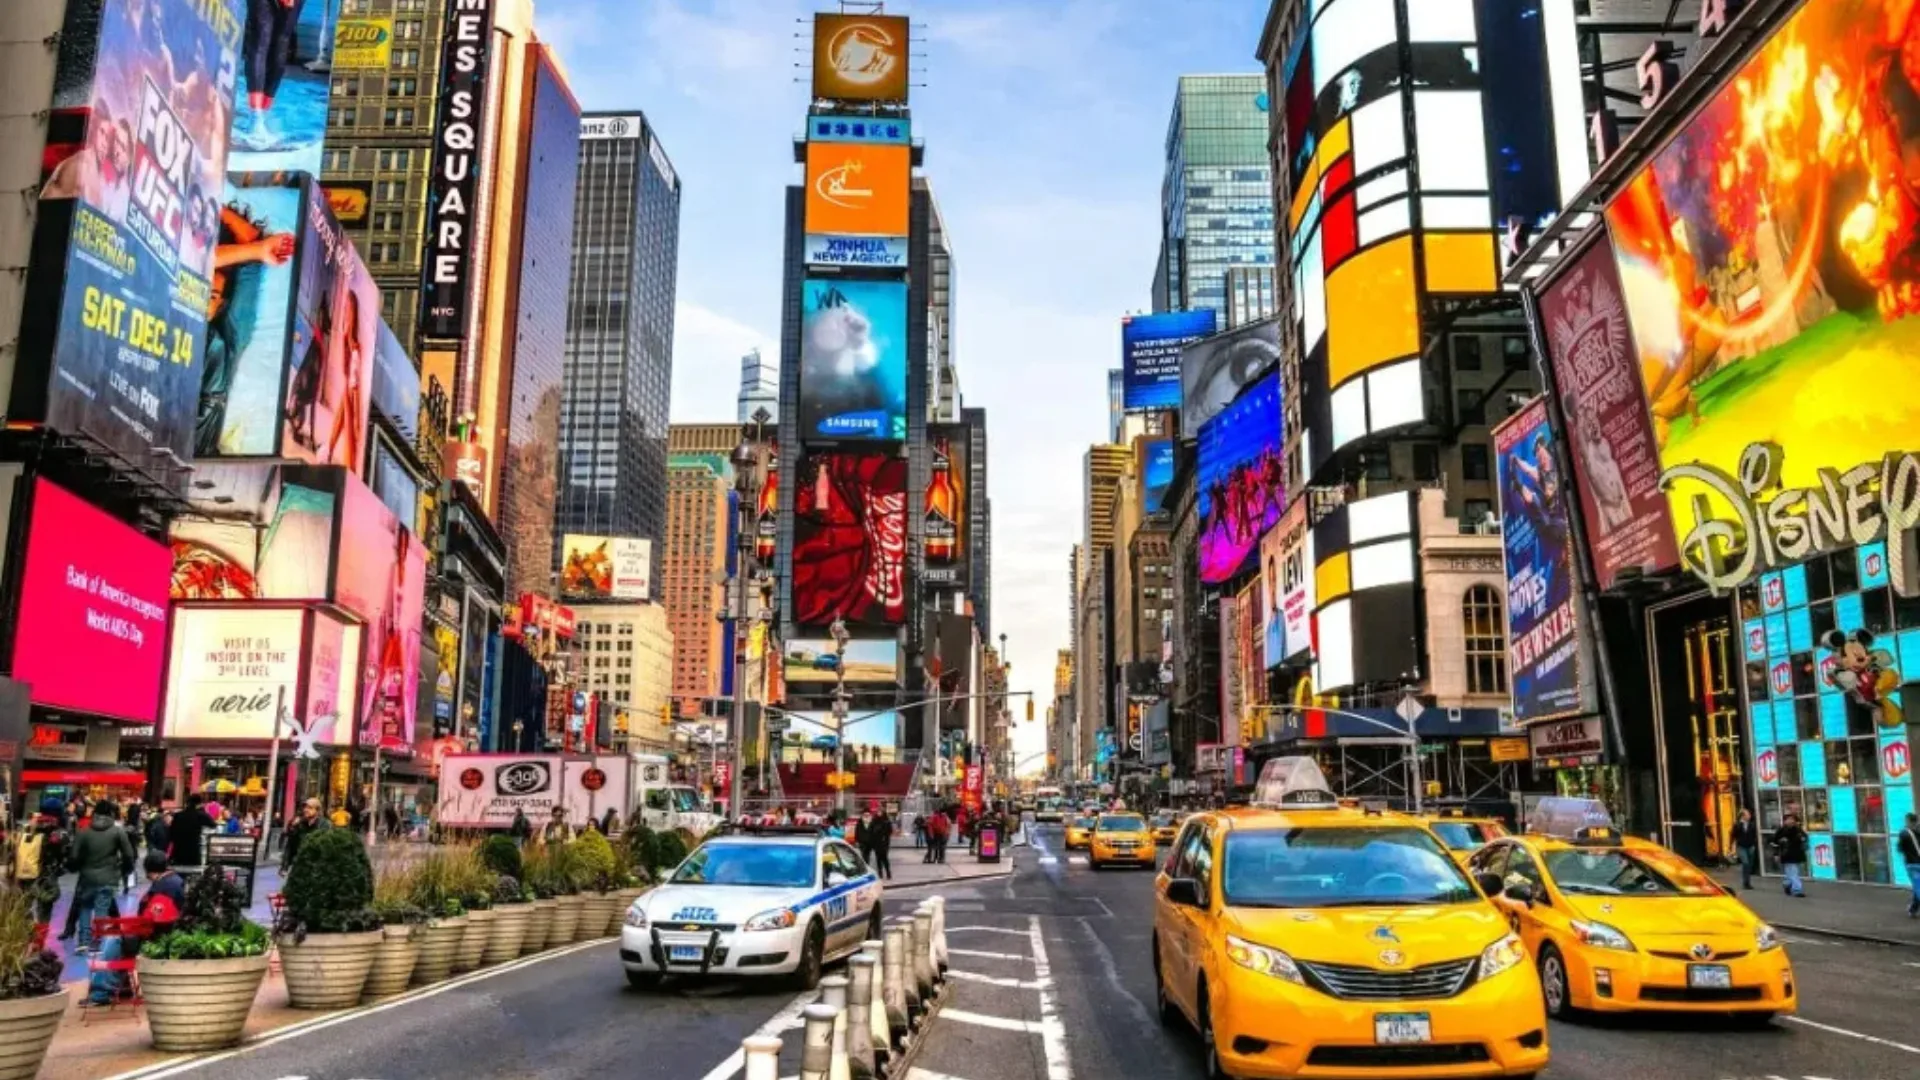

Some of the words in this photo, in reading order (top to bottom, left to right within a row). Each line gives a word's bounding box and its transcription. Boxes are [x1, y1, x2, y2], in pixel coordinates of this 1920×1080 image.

[140, 84, 191, 195] FOX
[134, 156, 182, 241] UFC
[435, 92, 475, 283] SQUARE
[127, 206, 178, 271] SATURDAY
[827, 239, 887, 252] XINHUA
[813, 251, 848, 262] NEWS
[850, 253, 900, 264] AGENCY
[431, 307, 455, 316] NYC
[82, 286, 127, 340] SAT.
[129, 307, 168, 359] DEC.
[170, 327, 193, 368] 14
[139, 386, 160, 422] FOX
[826, 418, 879, 429] SAMSUNG
[67, 563, 88, 590] Bank
[100, 579, 131, 608] America
[86, 607, 111, 633] World
[110, 616, 129, 640] AIDS
[129, 622, 144, 649] Day
[224, 637, 254, 649] VISIT
[206, 652, 243, 663] INSIDE
[247, 652, 263, 663] ON
[266, 652, 287, 663] THE
[239, 665, 271, 676] LEVEL
[209, 686, 272, 713] aerie
[671, 911, 718, 922] POLICE
